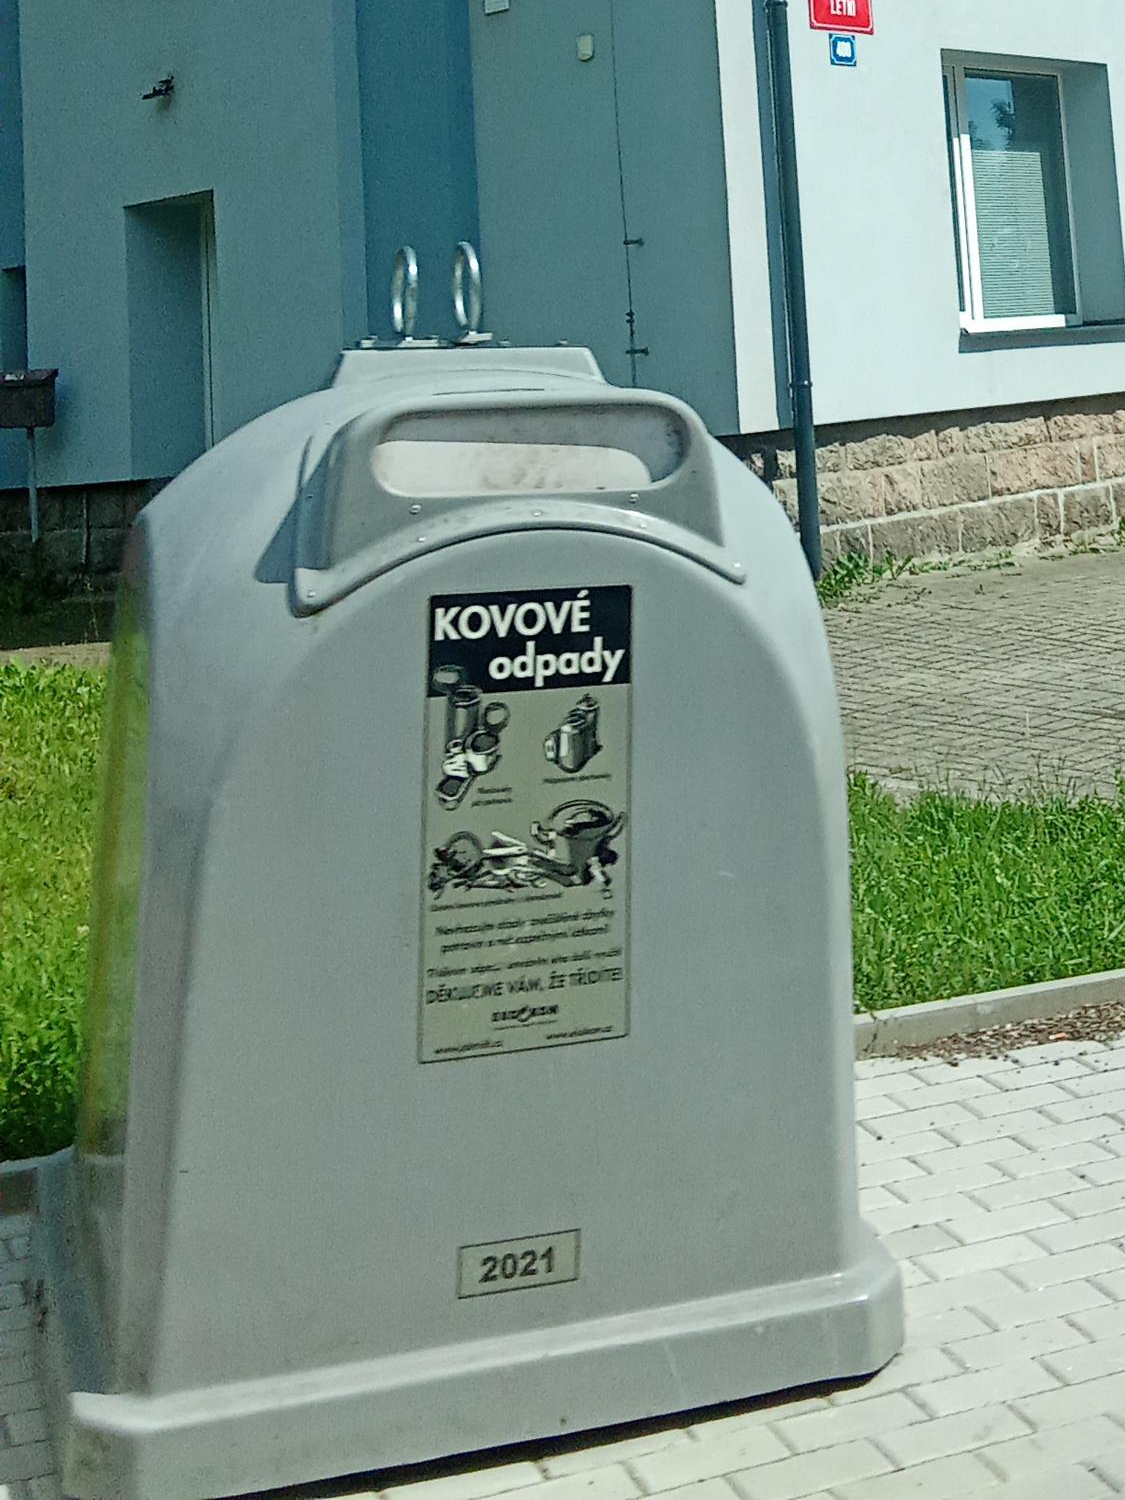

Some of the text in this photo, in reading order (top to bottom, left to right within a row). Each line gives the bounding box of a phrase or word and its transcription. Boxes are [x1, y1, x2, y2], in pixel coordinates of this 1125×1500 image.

[434, 590, 590, 641] KOVOVÉ
[488, 636, 625, 687] odpady
[479, 1246, 555, 1284] 2021
